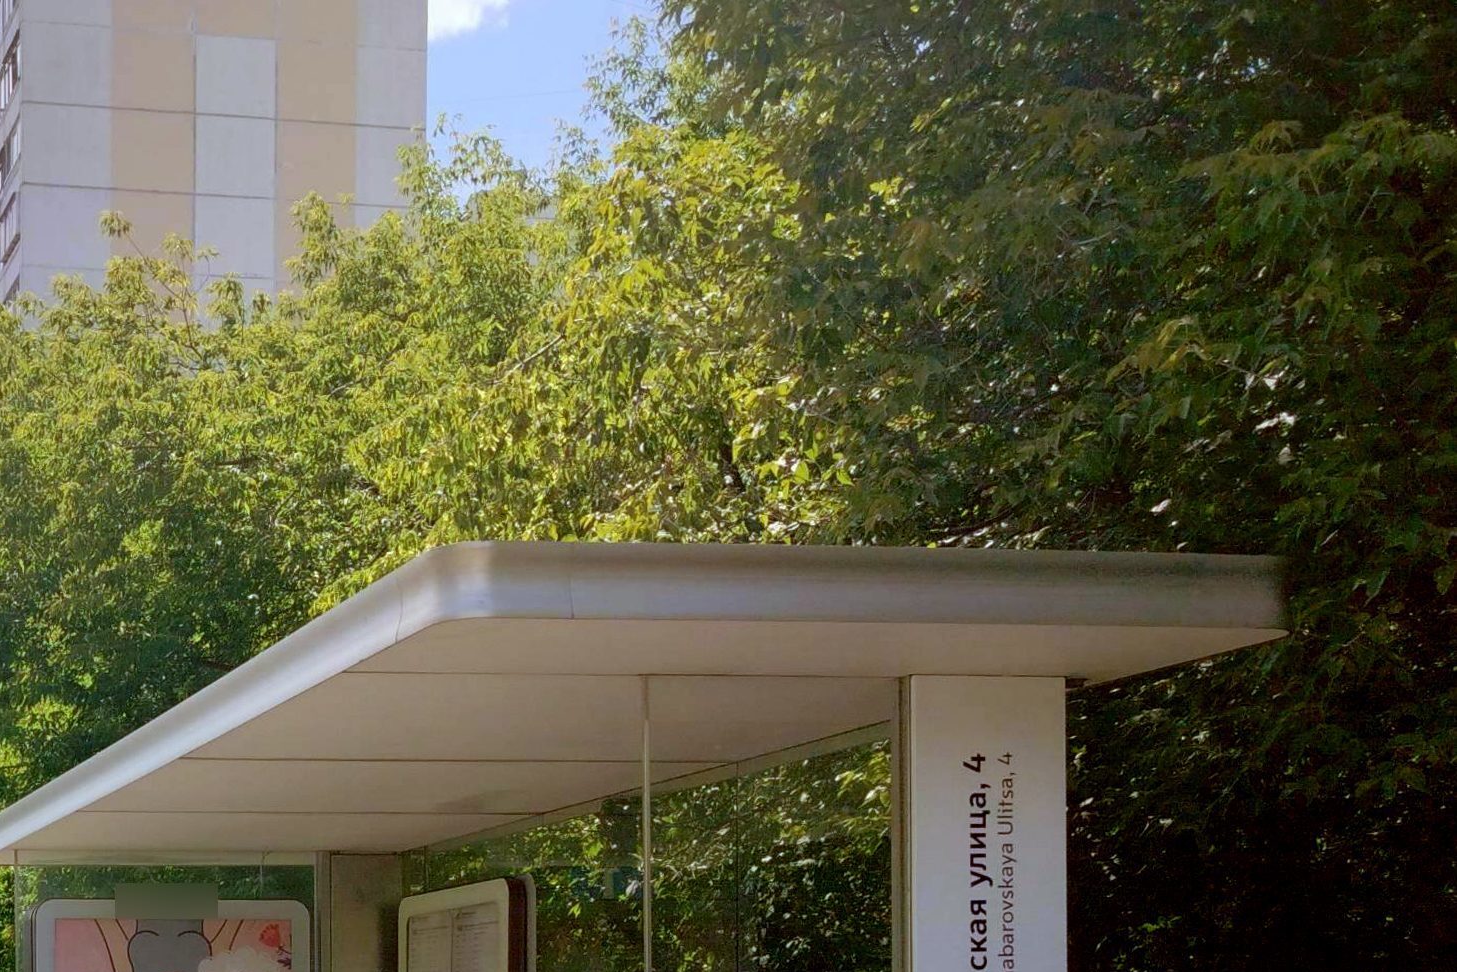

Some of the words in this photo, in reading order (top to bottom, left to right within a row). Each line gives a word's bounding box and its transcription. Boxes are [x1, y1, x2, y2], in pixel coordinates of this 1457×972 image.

[963, 753, 986, 773] 4
[998, 752, 1013, 766] 4
[997, 772, 1017, 836] Ulitsa,
[969, 783, 993, 888] улица,
